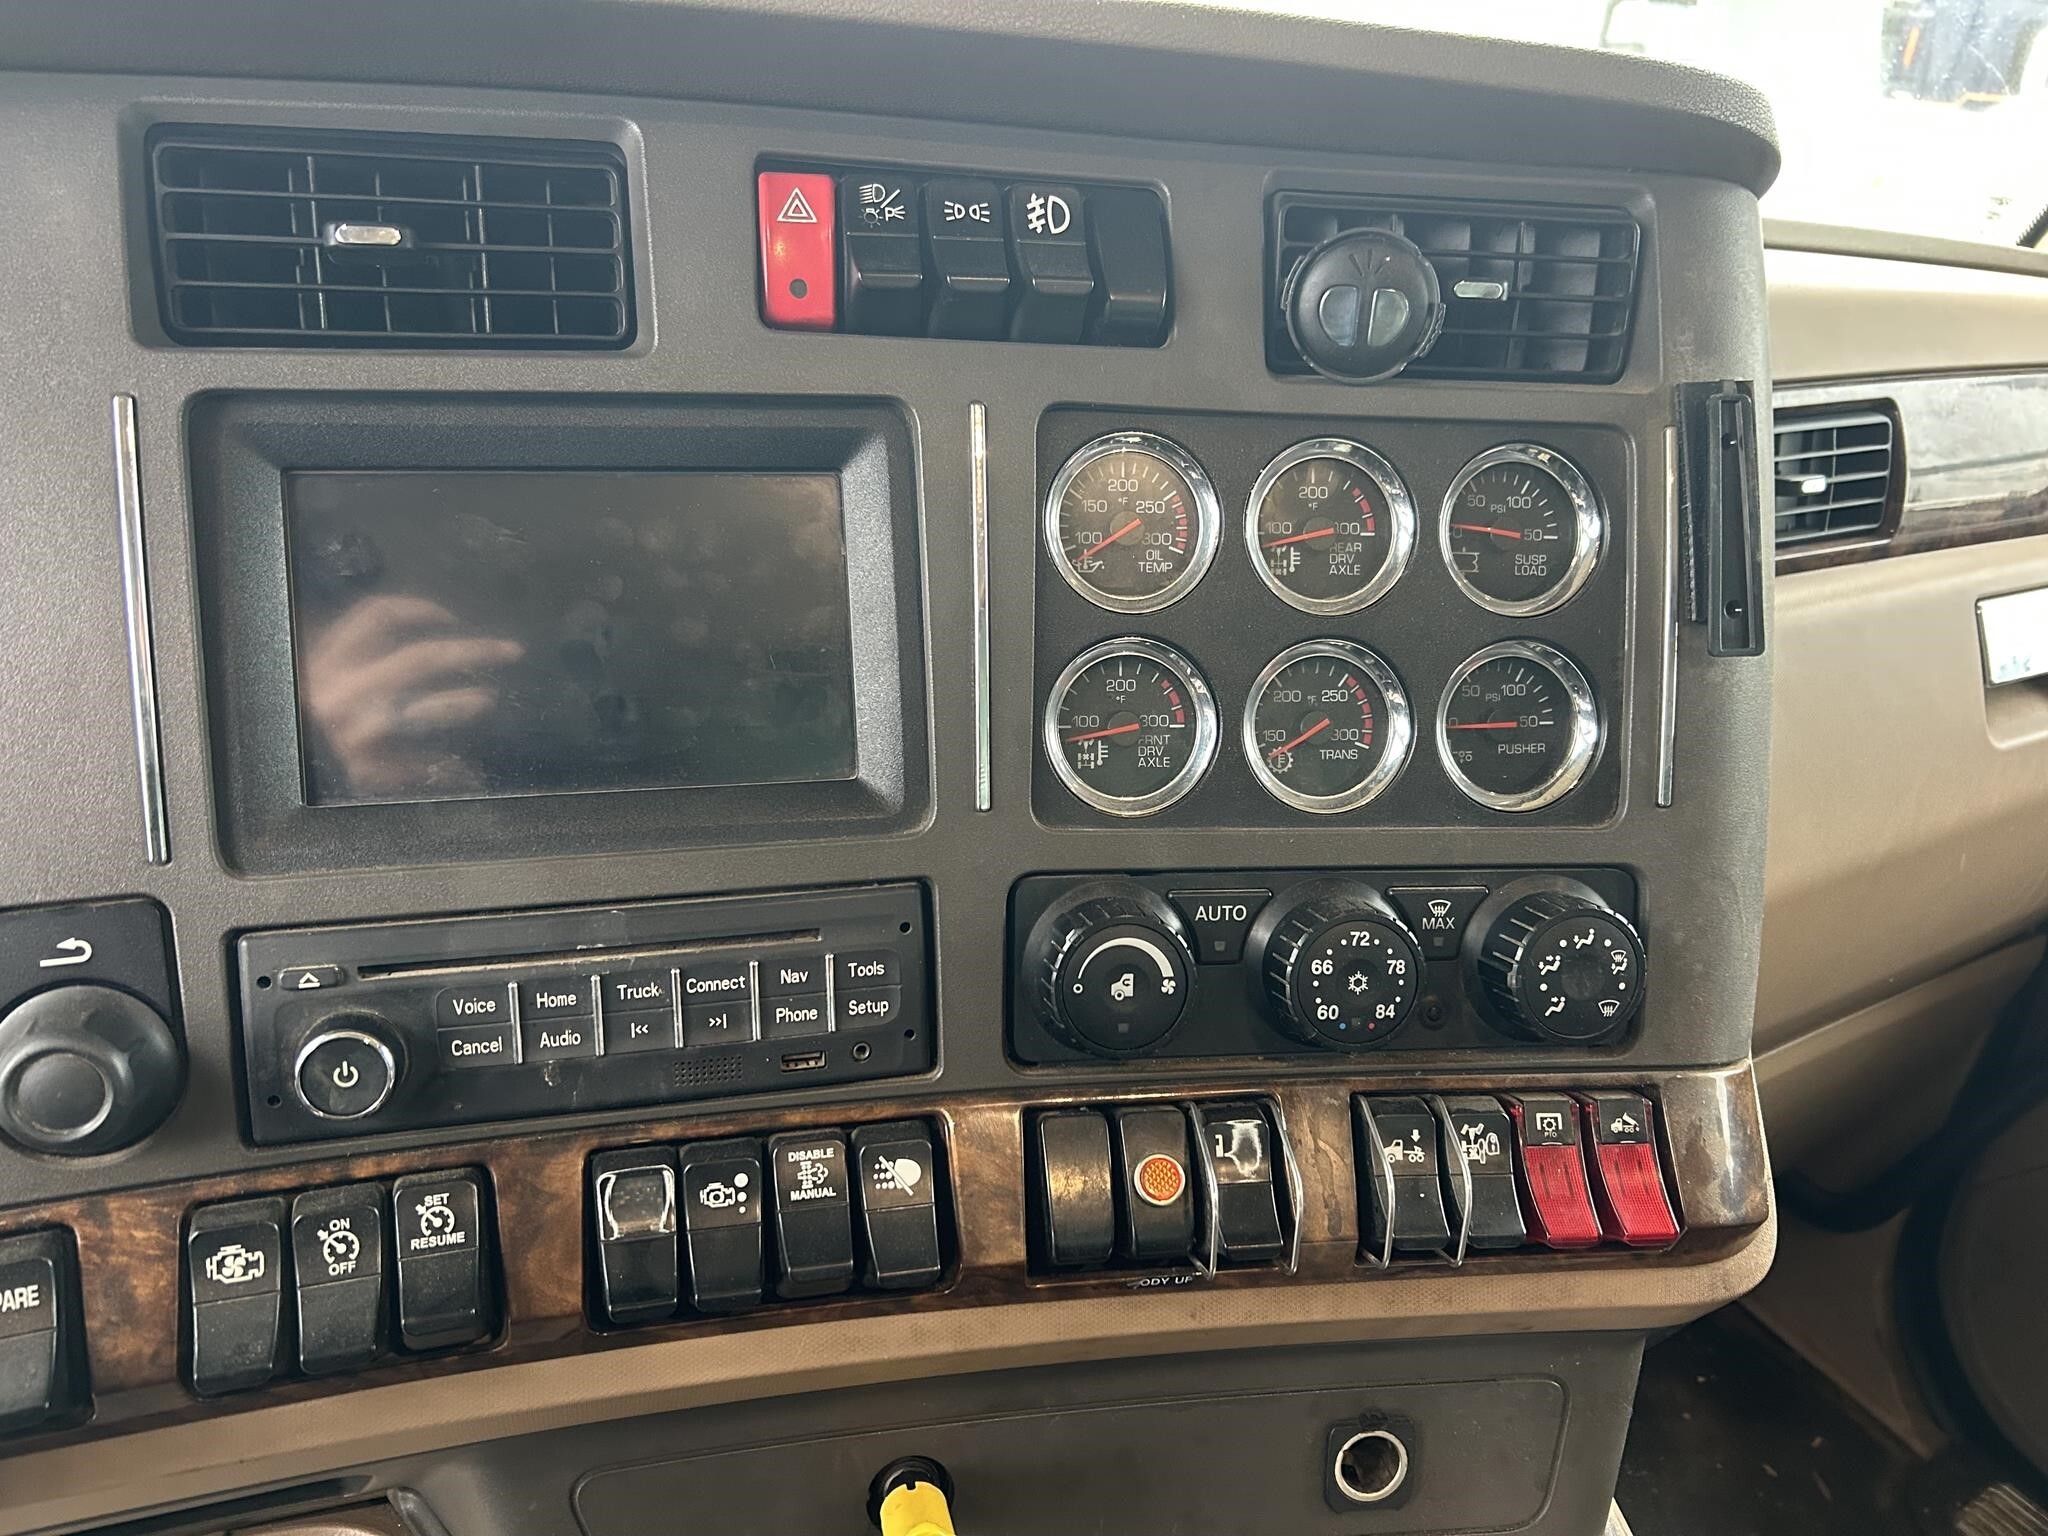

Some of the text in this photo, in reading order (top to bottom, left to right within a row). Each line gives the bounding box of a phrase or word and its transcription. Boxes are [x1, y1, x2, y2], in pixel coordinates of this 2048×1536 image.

[1107, 479, 1139, 493] 200
[1298, 486, 1328, 499] 200
[1081, 500, 1107, 513] 150
[1136, 500, 1165, 514] 250
[1467, 495, 1486, 507] 50
[1506, 496, 1532, 509] 100
[1490, 504, 1506, 513] PSI
[1267, 522, 1293, 534] 100
[1075, 531, 1103, 545] 100
[1141, 533, 1172, 546] 300
[1146, 550, 1164, 560] OIL
[1329, 553, 1355, 564] DRV
[1515, 554, 1547, 565] SUSP
[1138, 561, 1173, 573] TEMP
[1329, 565, 1361, 576] AXLE
[1514, 565, 1547, 576] LOAD
[1106, 679, 1137, 692] 200
[1461, 685, 1480, 697] 50
[1500, 684, 1526, 696] 100
[1273, 690, 1302, 703] 200
[1321, 689, 1348, 702] 250
[1485, 693, 1501, 701] PSI
[1072, 715, 1100, 728] 100
[1139, 715, 1170, 728] 300
[1263, 729, 1286, 742] 150
[1331, 729, 1359, 741] 300
[1138, 746, 1165, 757] DRV
[1320, 749, 1359, 760] TRANS
[1498, 744, 1546, 755] PUSHER
[1138, 757, 1171, 768] AXLE
[1194, 905, 1247, 922] AUTO
[1422, 917, 1455, 930] MAX
[1350, 931, 1370, 947] 72
[847, 961, 885, 978] Tools
[1311, 960, 1334, 975] 66
[1387, 960, 1406, 975] 78
[780, 969, 809, 984] Nav
[616, 981, 660, 1001] Truck
[686, 975, 746, 994] Connect
[452, 997, 497, 1016] Voice
[536, 991, 578, 1009] Home
[848, 1000, 890, 1017] Setup
[1316, 1005, 1339, 1020] 60
[1375, 1004, 1396, 1019] 84
[775, 1007, 818, 1024] Phone
[539, 1029, 582, 1049] Audio
[451, 1035, 503, 1057] Cancel
[787, 1147, 836, 1163] DISABLE
[424, 1192, 450, 1207] SET
[790, 1186, 837, 1201] MANUAL
[329, 1217, 350, 1232] ON
[410, 1231, 466, 1250] RESUME
[328, 1260, 357, 1276] OFF
